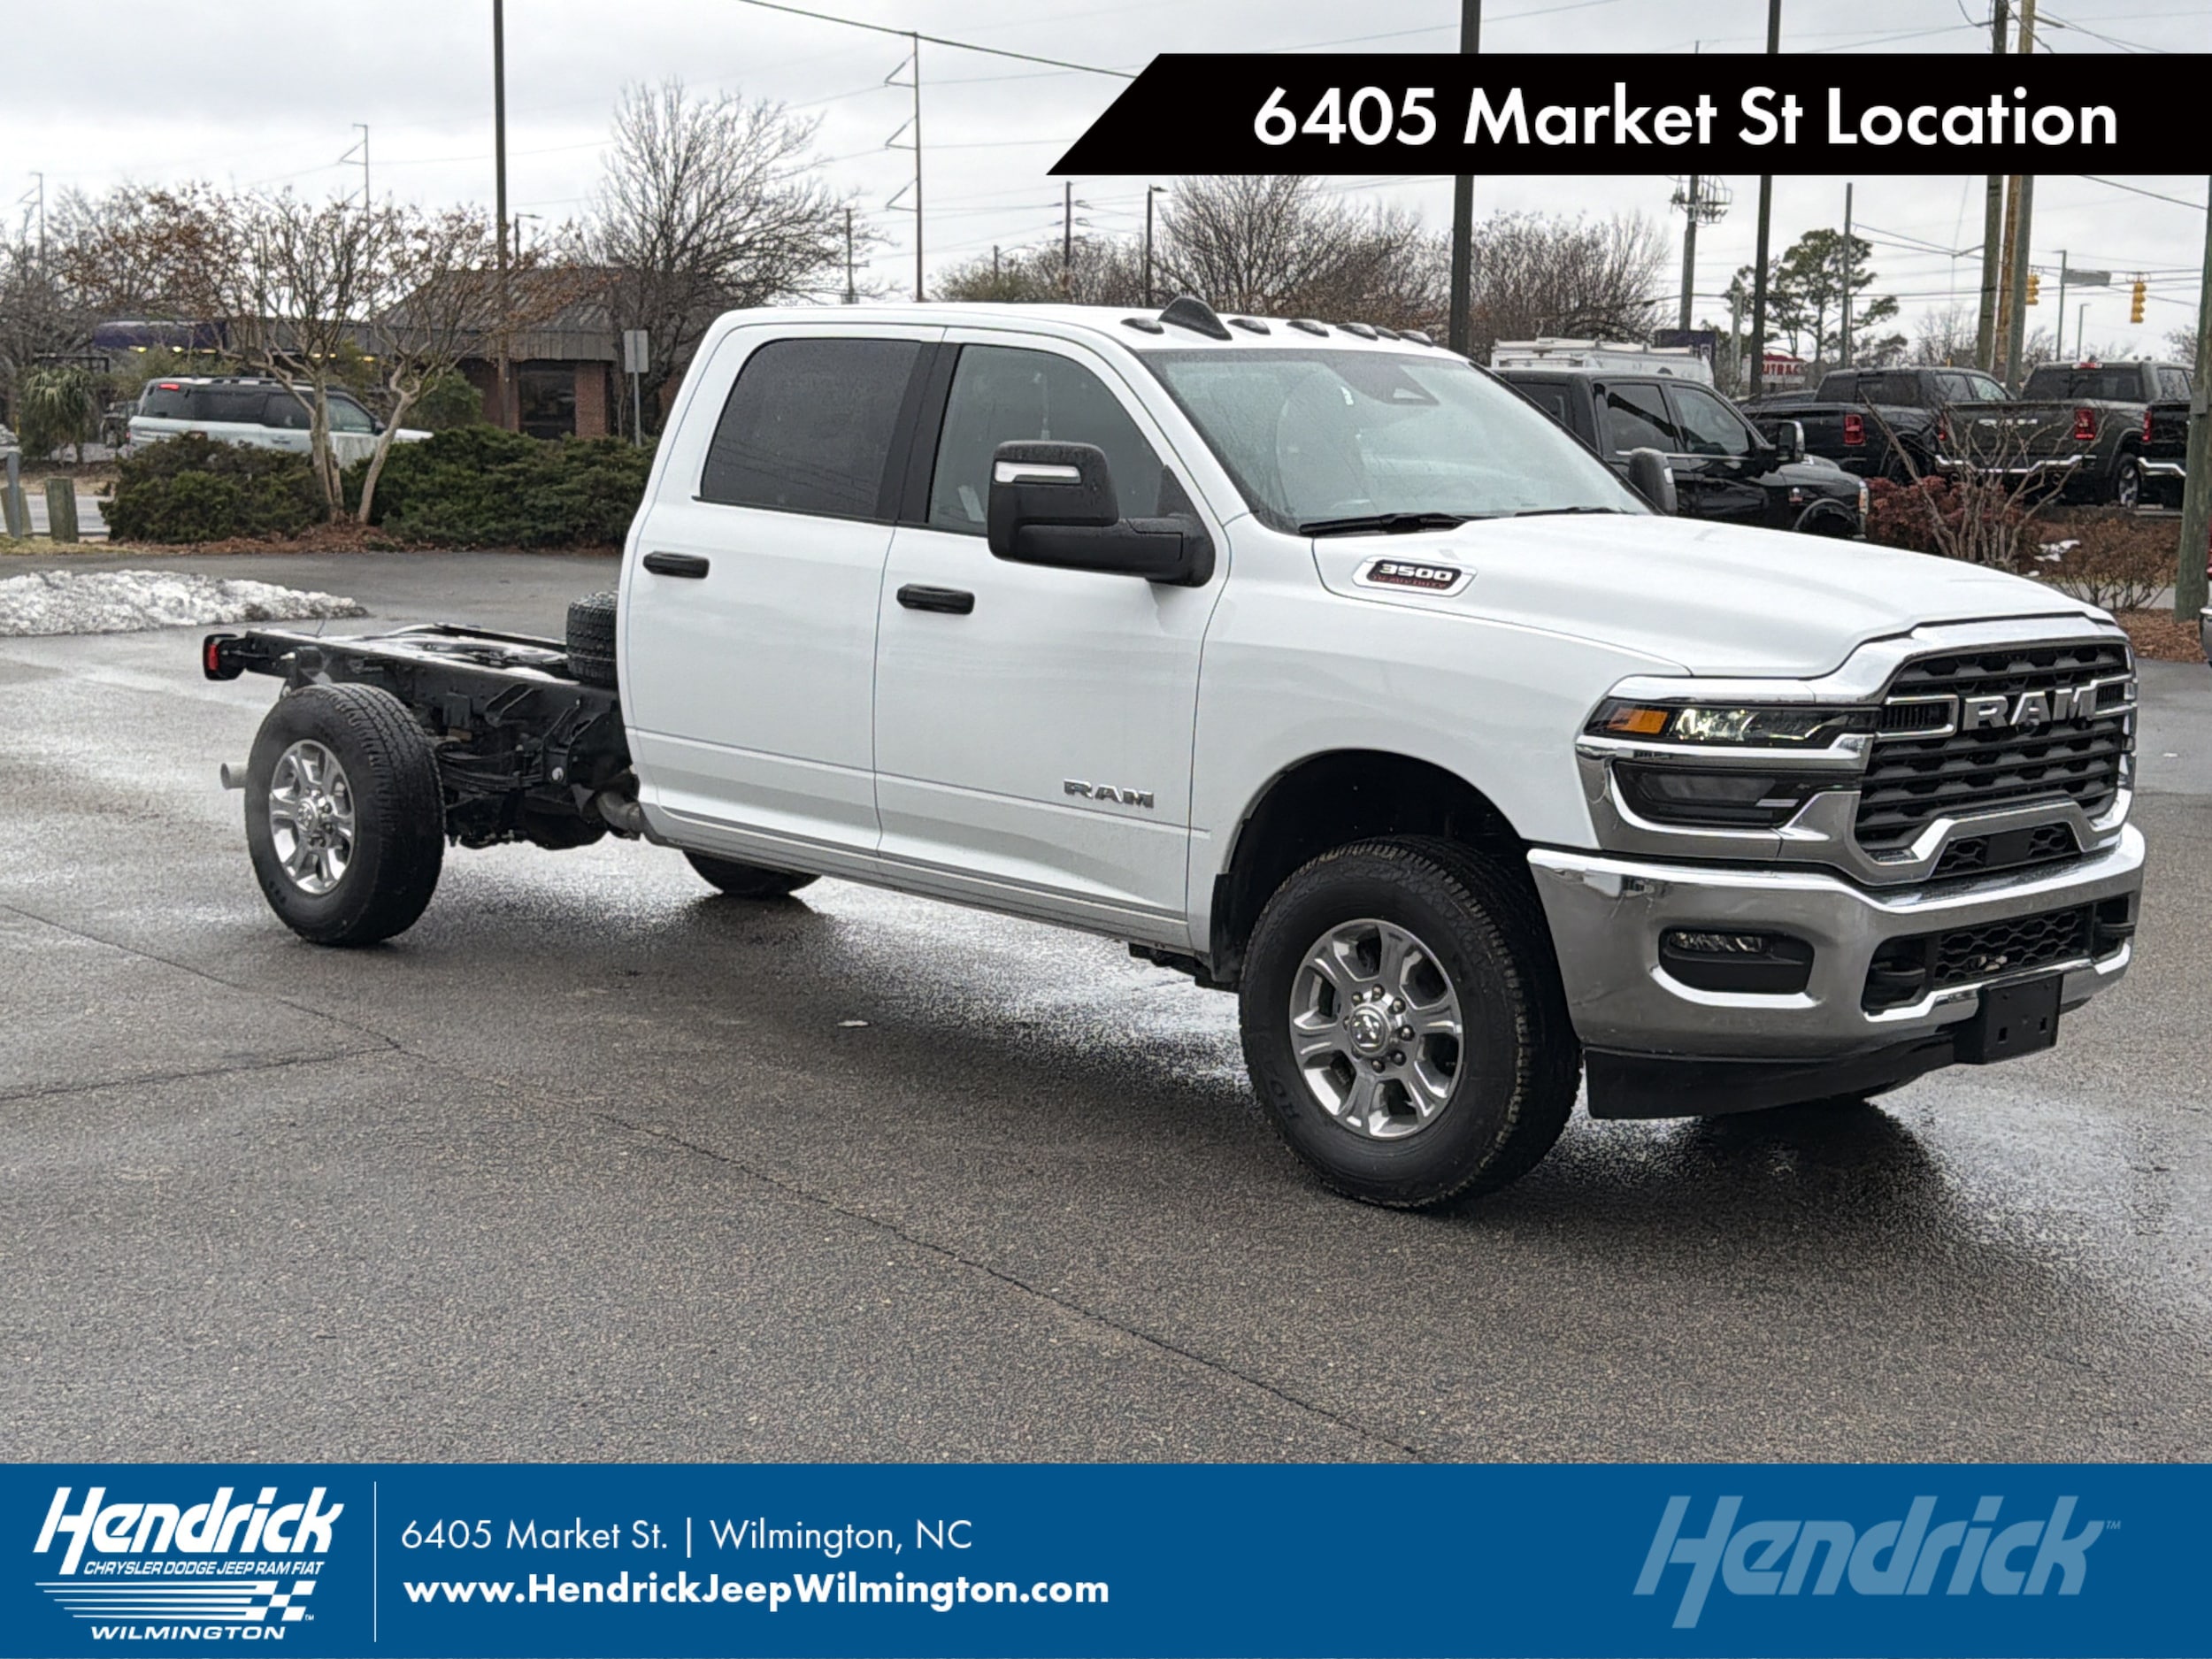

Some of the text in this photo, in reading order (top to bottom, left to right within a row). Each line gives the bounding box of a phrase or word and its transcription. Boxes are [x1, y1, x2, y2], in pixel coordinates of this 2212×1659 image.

[1379, 564, 1453, 581] 3500
[1962, 685, 2098, 732] RAM
[1064, 779, 1154, 809] RAM
